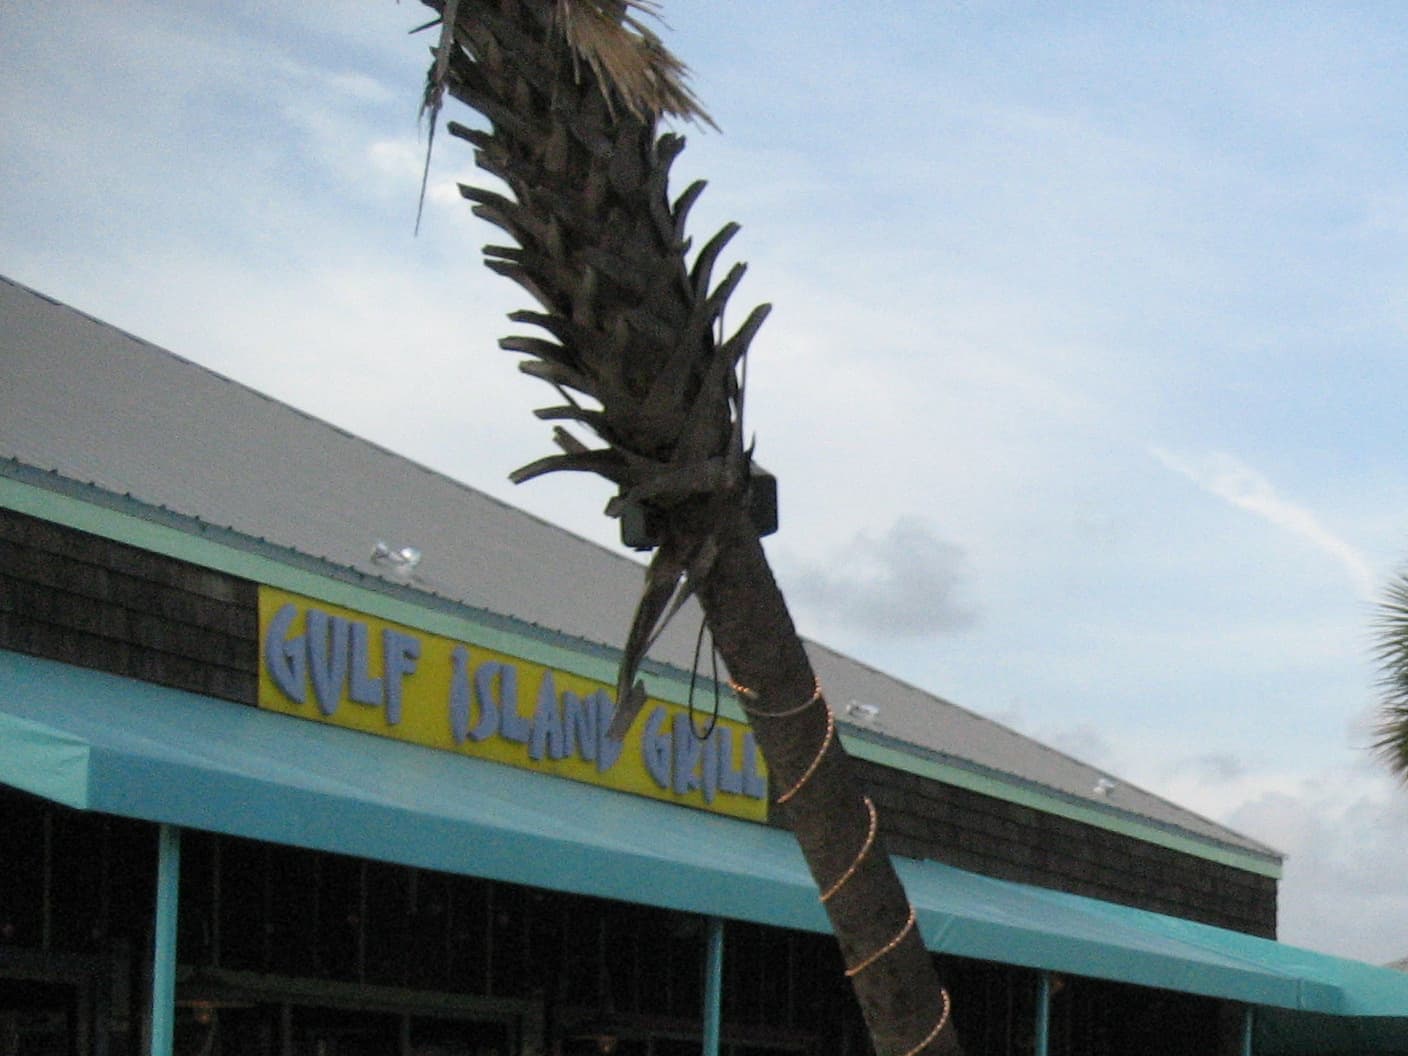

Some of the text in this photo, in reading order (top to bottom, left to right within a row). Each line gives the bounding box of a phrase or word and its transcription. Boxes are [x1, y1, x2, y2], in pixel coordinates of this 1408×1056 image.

[265, 603, 767, 803] GULF ISLAND GRILL
